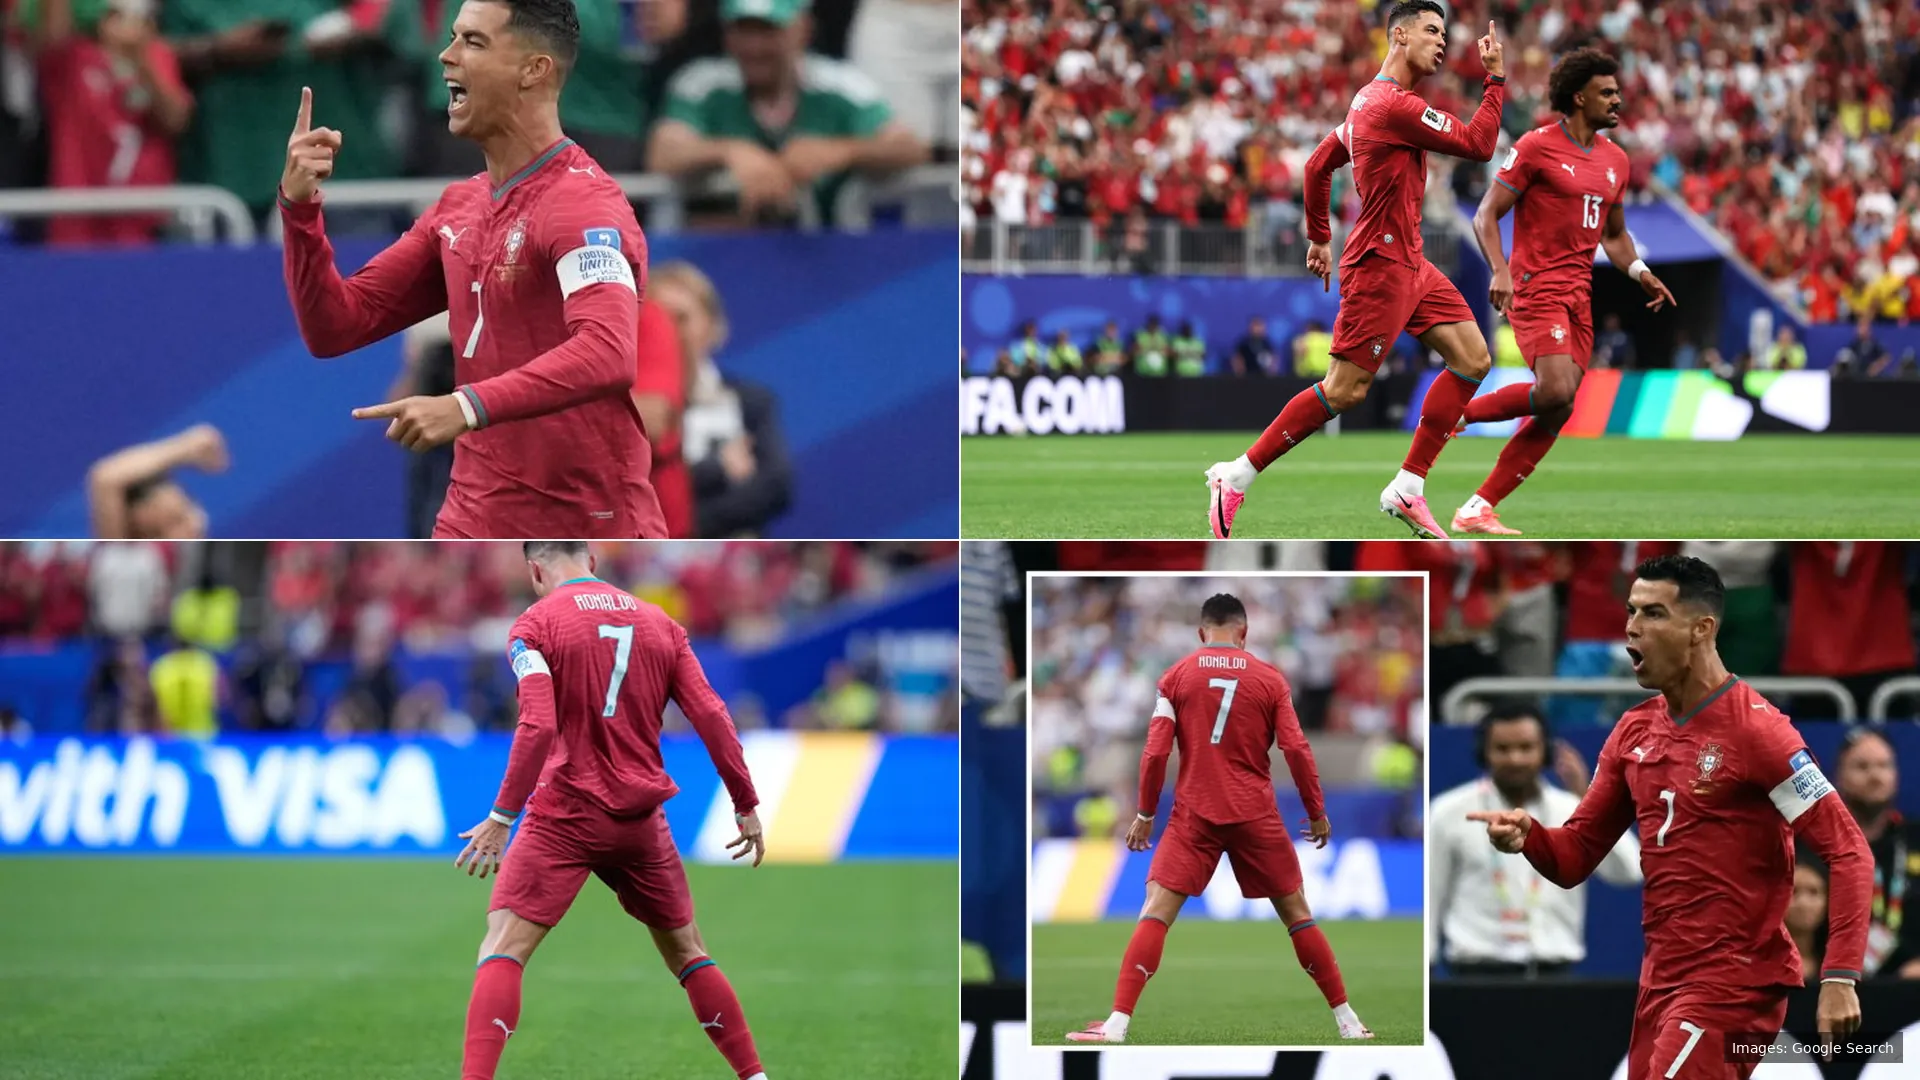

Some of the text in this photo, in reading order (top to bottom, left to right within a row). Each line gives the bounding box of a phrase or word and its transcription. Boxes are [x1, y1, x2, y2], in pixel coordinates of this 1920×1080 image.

[1582, 193, 1603, 229] 13
[462, 280, 484, 359] 7
[573, 593, 638, 612] RONALDO
[598, 623, 634, 717] 7
[1198, 655, 1247, 670] RONALDO
[1208, 678, 1239, 744] 7
[207, 744, 447, 848] VISA
[1656, 788, 1676, 847] 7
[1664, 1020, 1706, 1080] 7
